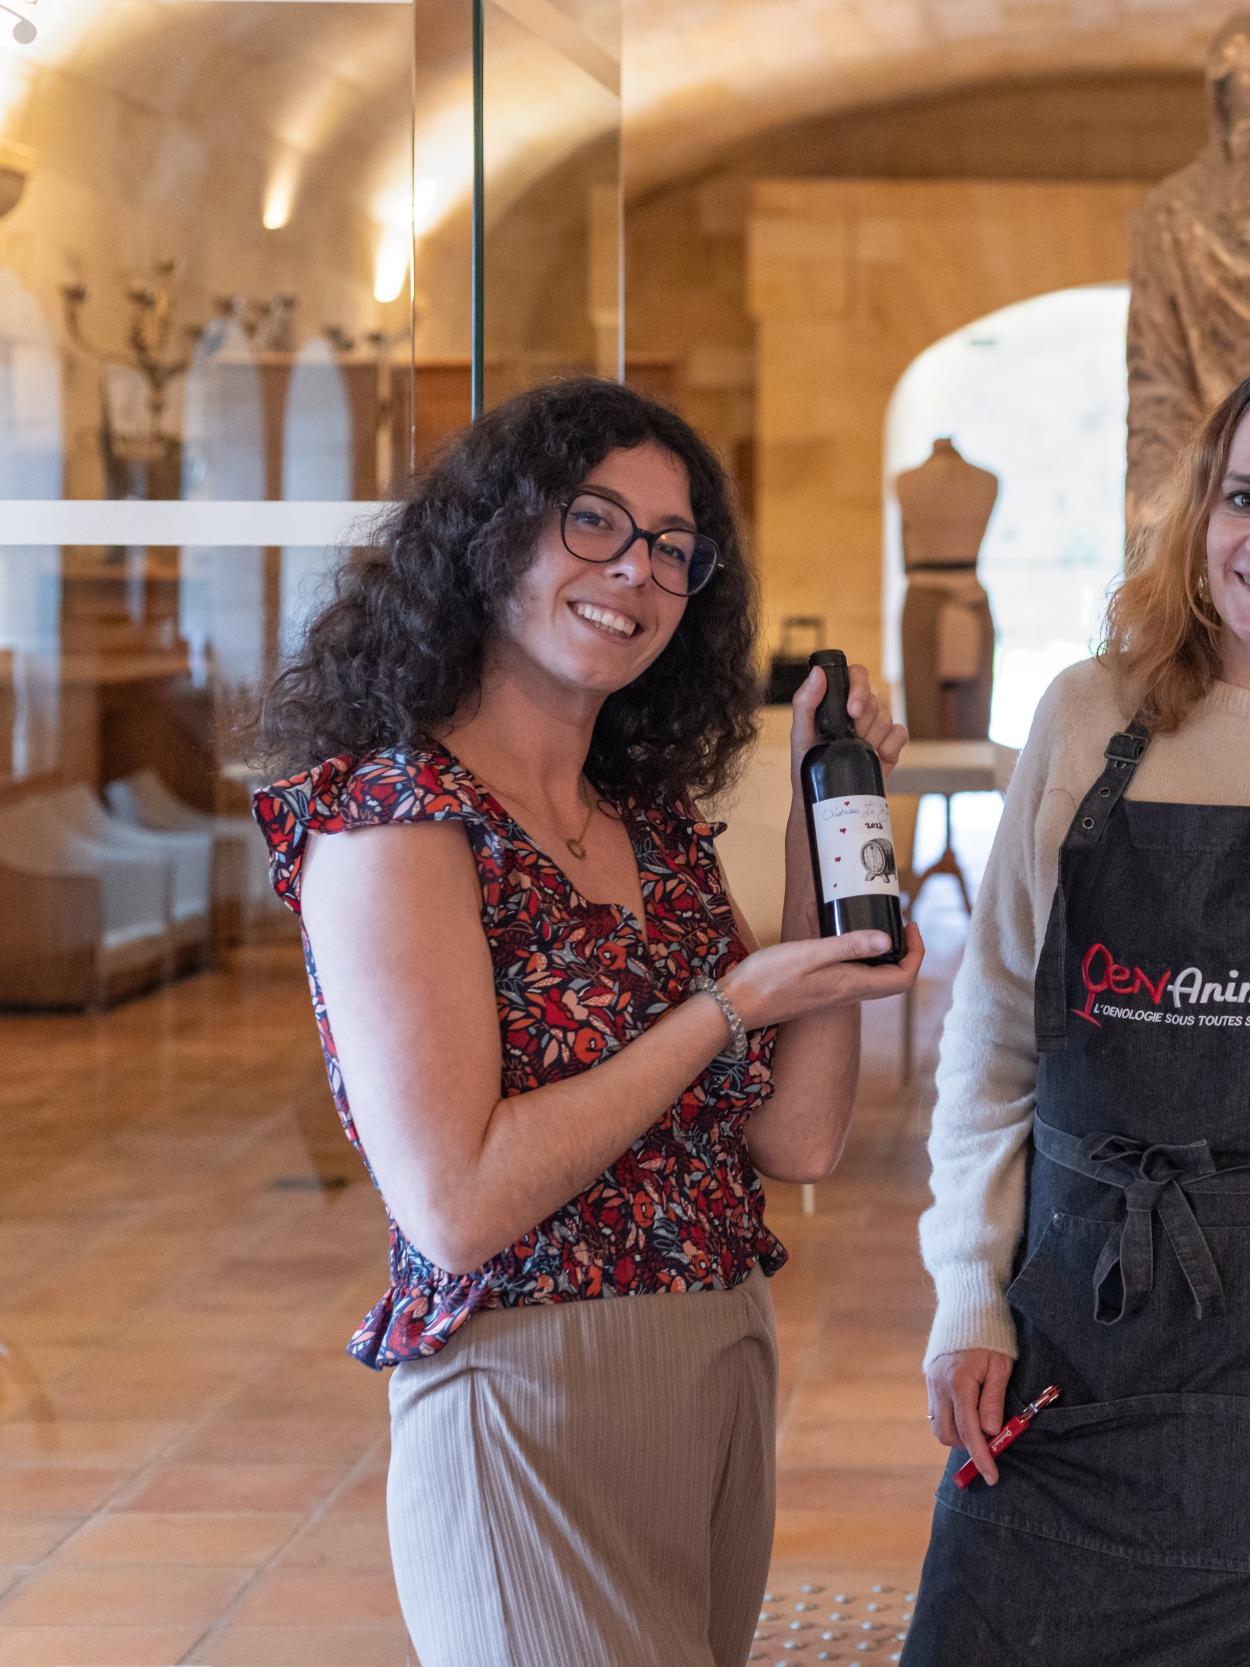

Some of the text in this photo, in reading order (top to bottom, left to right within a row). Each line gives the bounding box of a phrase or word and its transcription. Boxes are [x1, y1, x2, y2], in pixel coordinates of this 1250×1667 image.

[1093, 1002, 1164, 1023] L'OENOLOGIE
[1164, 1012, 1195, 1026] SOUS
[1198, 1015, 1243, 1026] TOUTES
